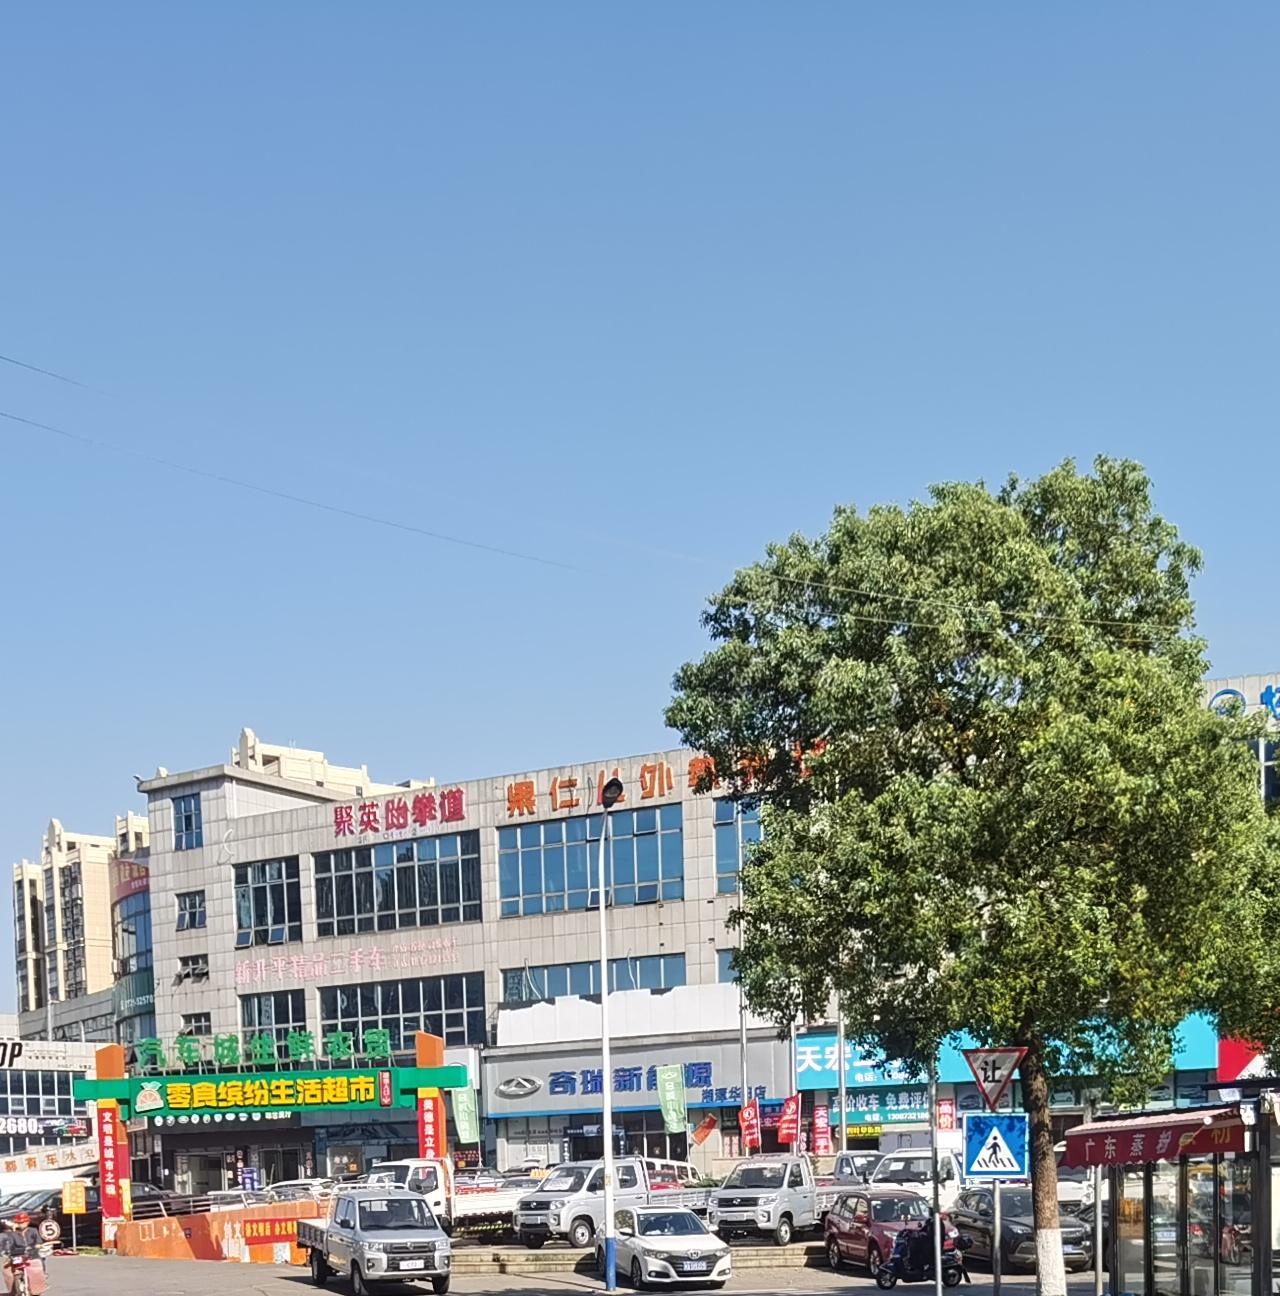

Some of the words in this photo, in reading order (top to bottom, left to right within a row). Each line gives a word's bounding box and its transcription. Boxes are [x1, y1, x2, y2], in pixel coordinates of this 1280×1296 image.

[334, 788, 466, 838] 聚英跆拳道
[981, 1060, 1002, 1083] 让
[166, 1075, 376, 1109] 零食缤纷生活超市
[939, 1102, 953, 1130] 高价
[45, 1224, 55, 1236] 5
